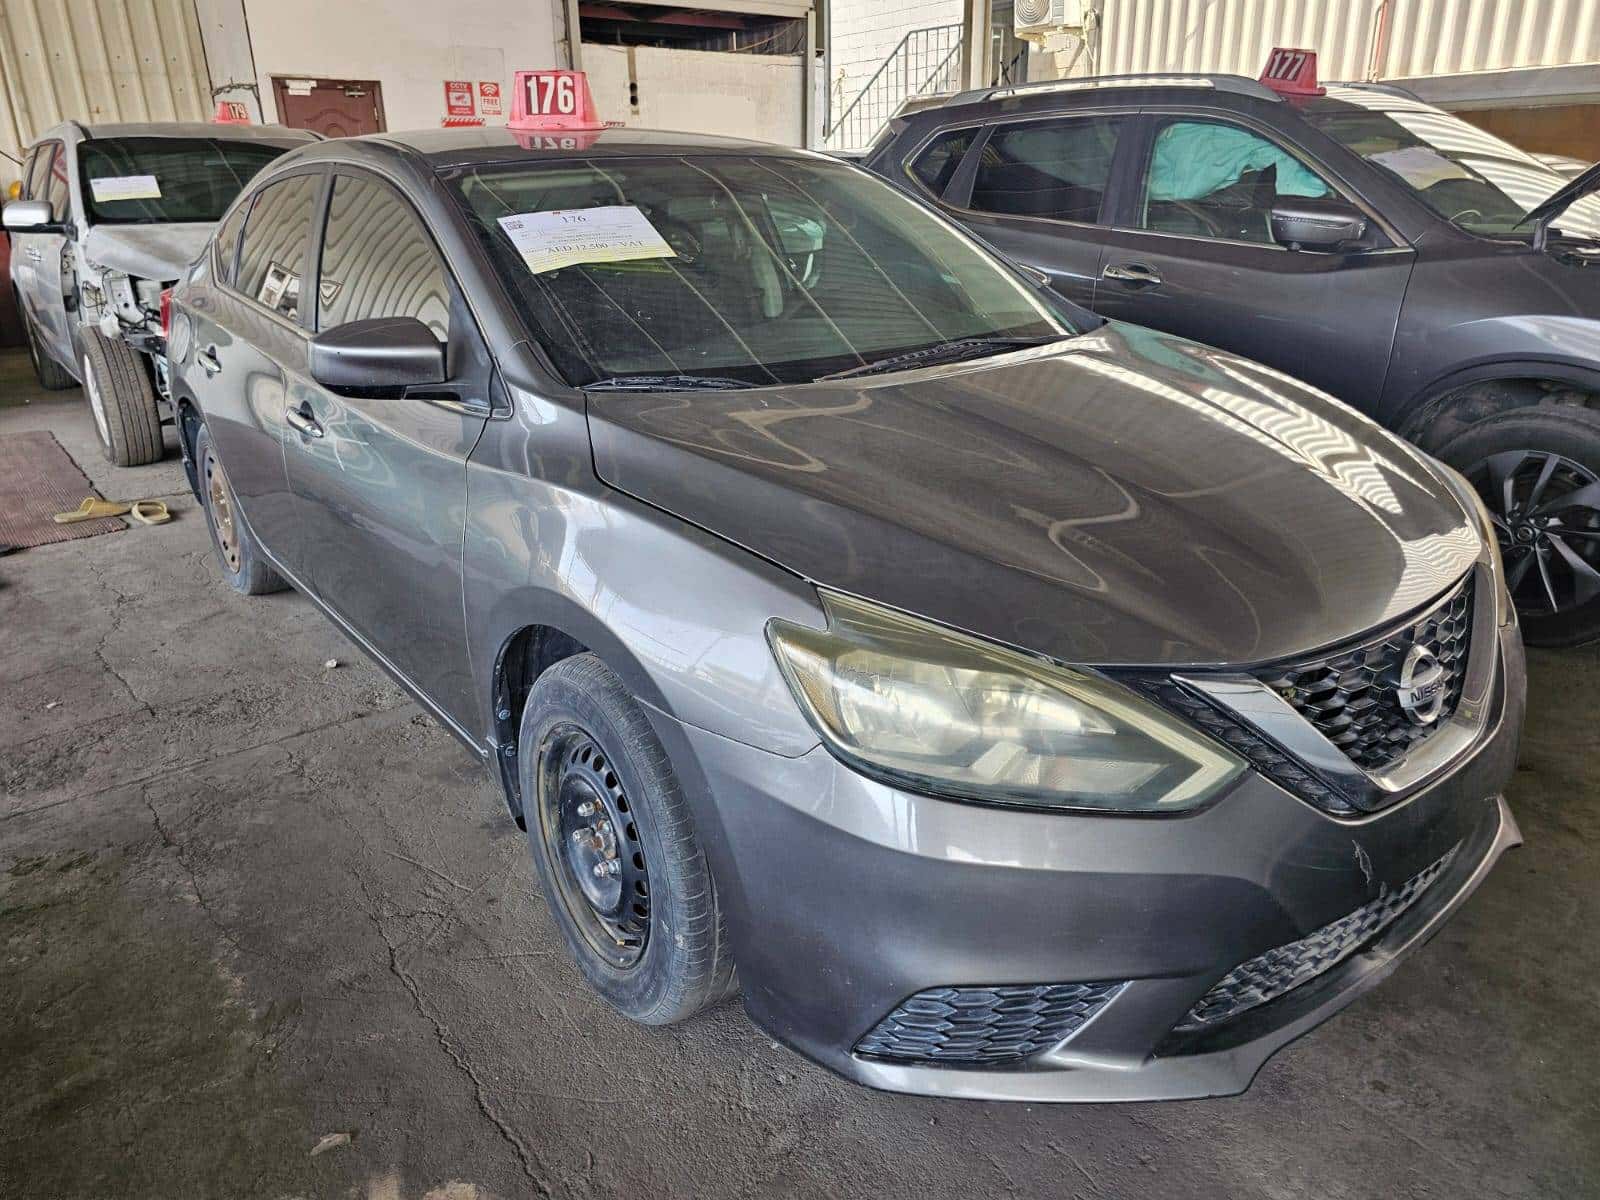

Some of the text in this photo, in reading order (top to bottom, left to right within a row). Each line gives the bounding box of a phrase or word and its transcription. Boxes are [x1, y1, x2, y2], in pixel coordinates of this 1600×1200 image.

[1268, 51, 1306, 80] 177
[483, 98, 499, 106] FREE
[526, 76, 575, 114] 176
[561, 215, 586, 224] 176
[547, 245, 572, 254] AED
[1410, 680, 1444, 703] NISS
